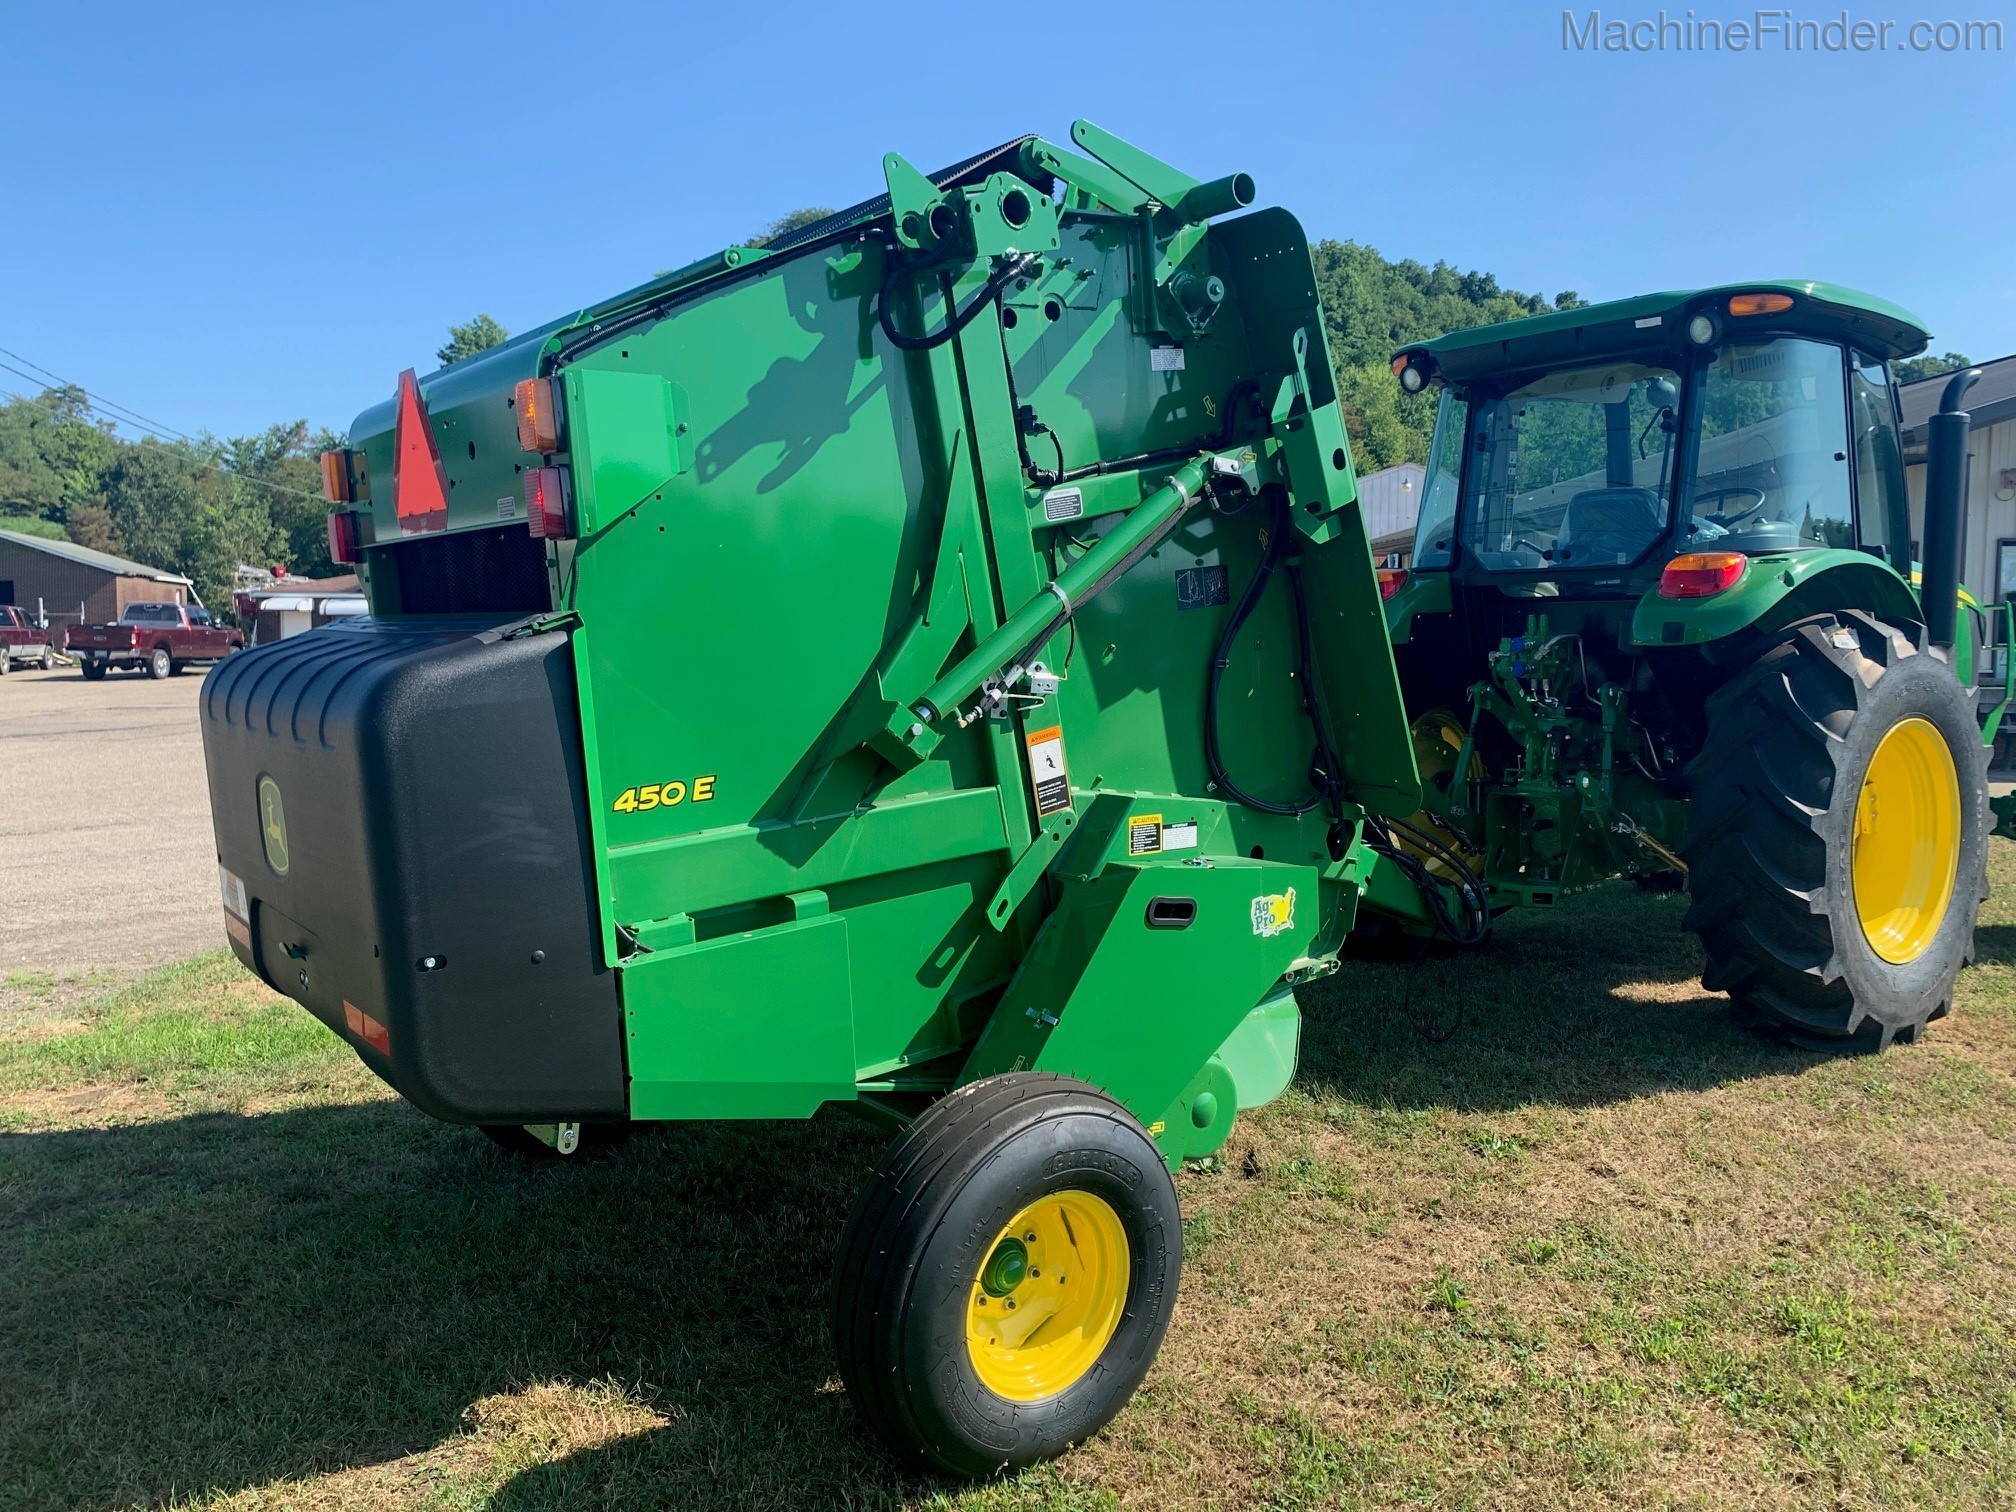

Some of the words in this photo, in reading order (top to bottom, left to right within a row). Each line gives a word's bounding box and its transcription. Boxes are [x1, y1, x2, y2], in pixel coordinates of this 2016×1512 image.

[612, 779, 687, 814] 450
[691, 775, 717, 803] E
[1137, 816, 1159, 824] CAUTION
[1253, 900, 1274, 917] Ag-
[1253, 913, 1276, 931] Pro
[1052, 1150, 1138, 1183] CARLISLE
